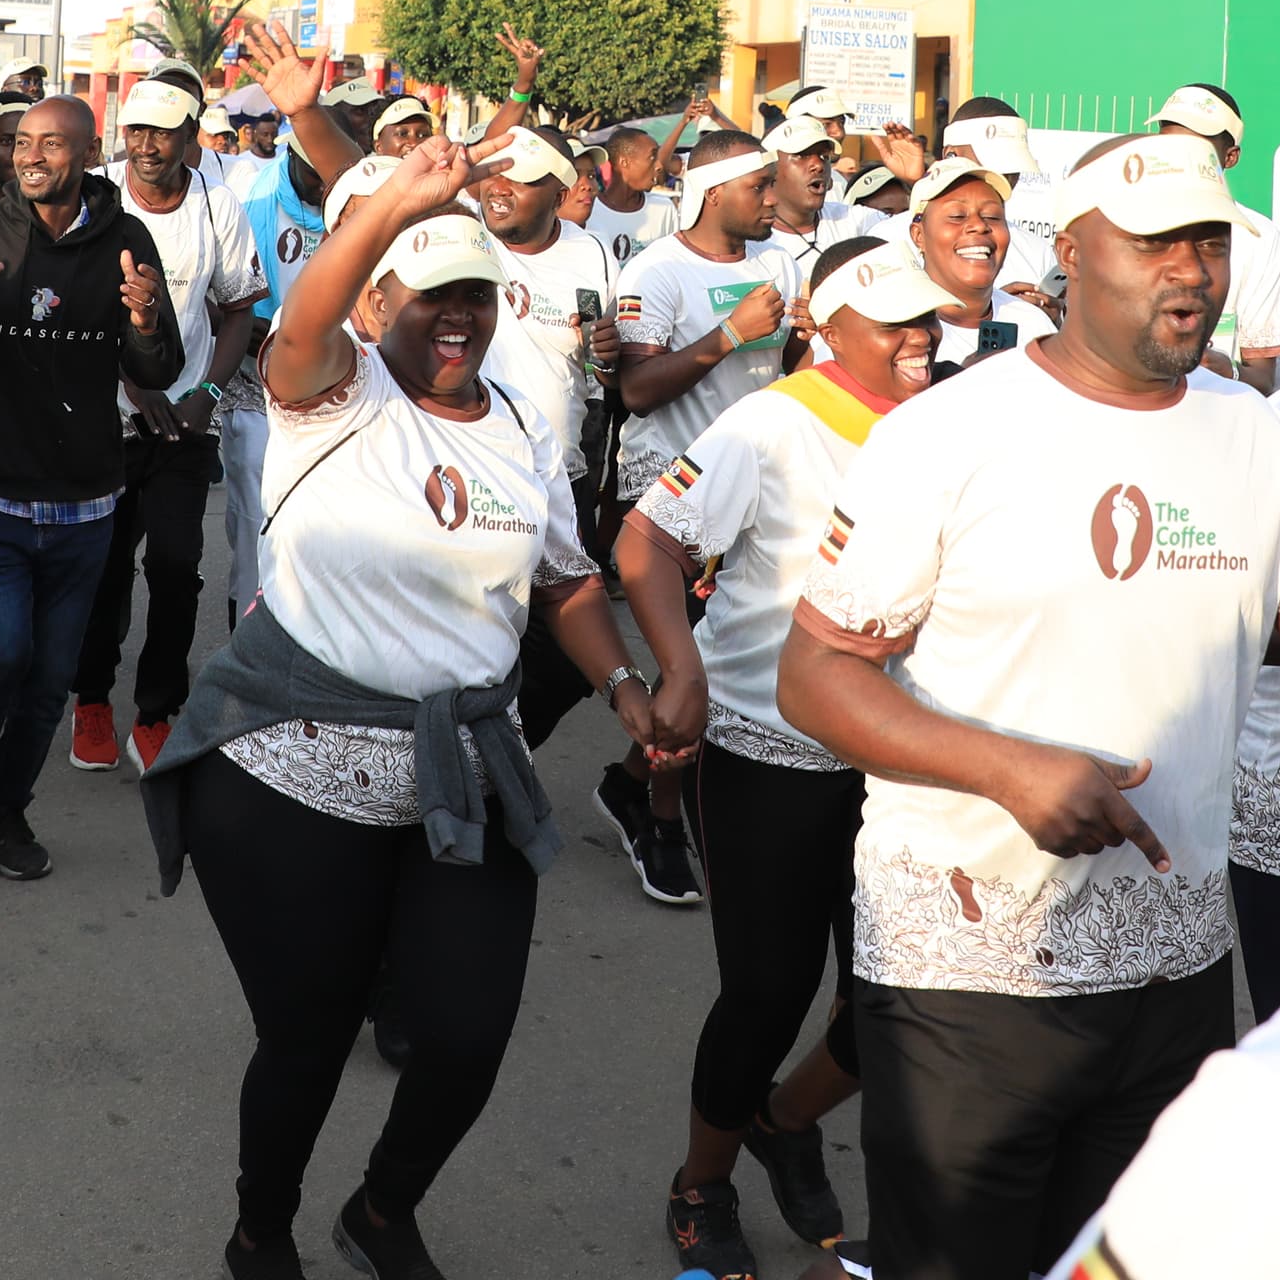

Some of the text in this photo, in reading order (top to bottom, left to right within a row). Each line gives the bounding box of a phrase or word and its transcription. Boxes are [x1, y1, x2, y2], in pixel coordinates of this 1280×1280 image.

[810, 30, 908, 49] UNISEX SALON
[856, 102, 892, 115] FRESH
[531, 304, 563, 317] Coffee
[469, 497, 516, 516] Coffee
[1154, 502, 1190, 523] The
[472, 514, 538, 536] Marathon
[1155, 525, 1217, 549] Coffee
[1156, 549, 1249, 571] Marathon
